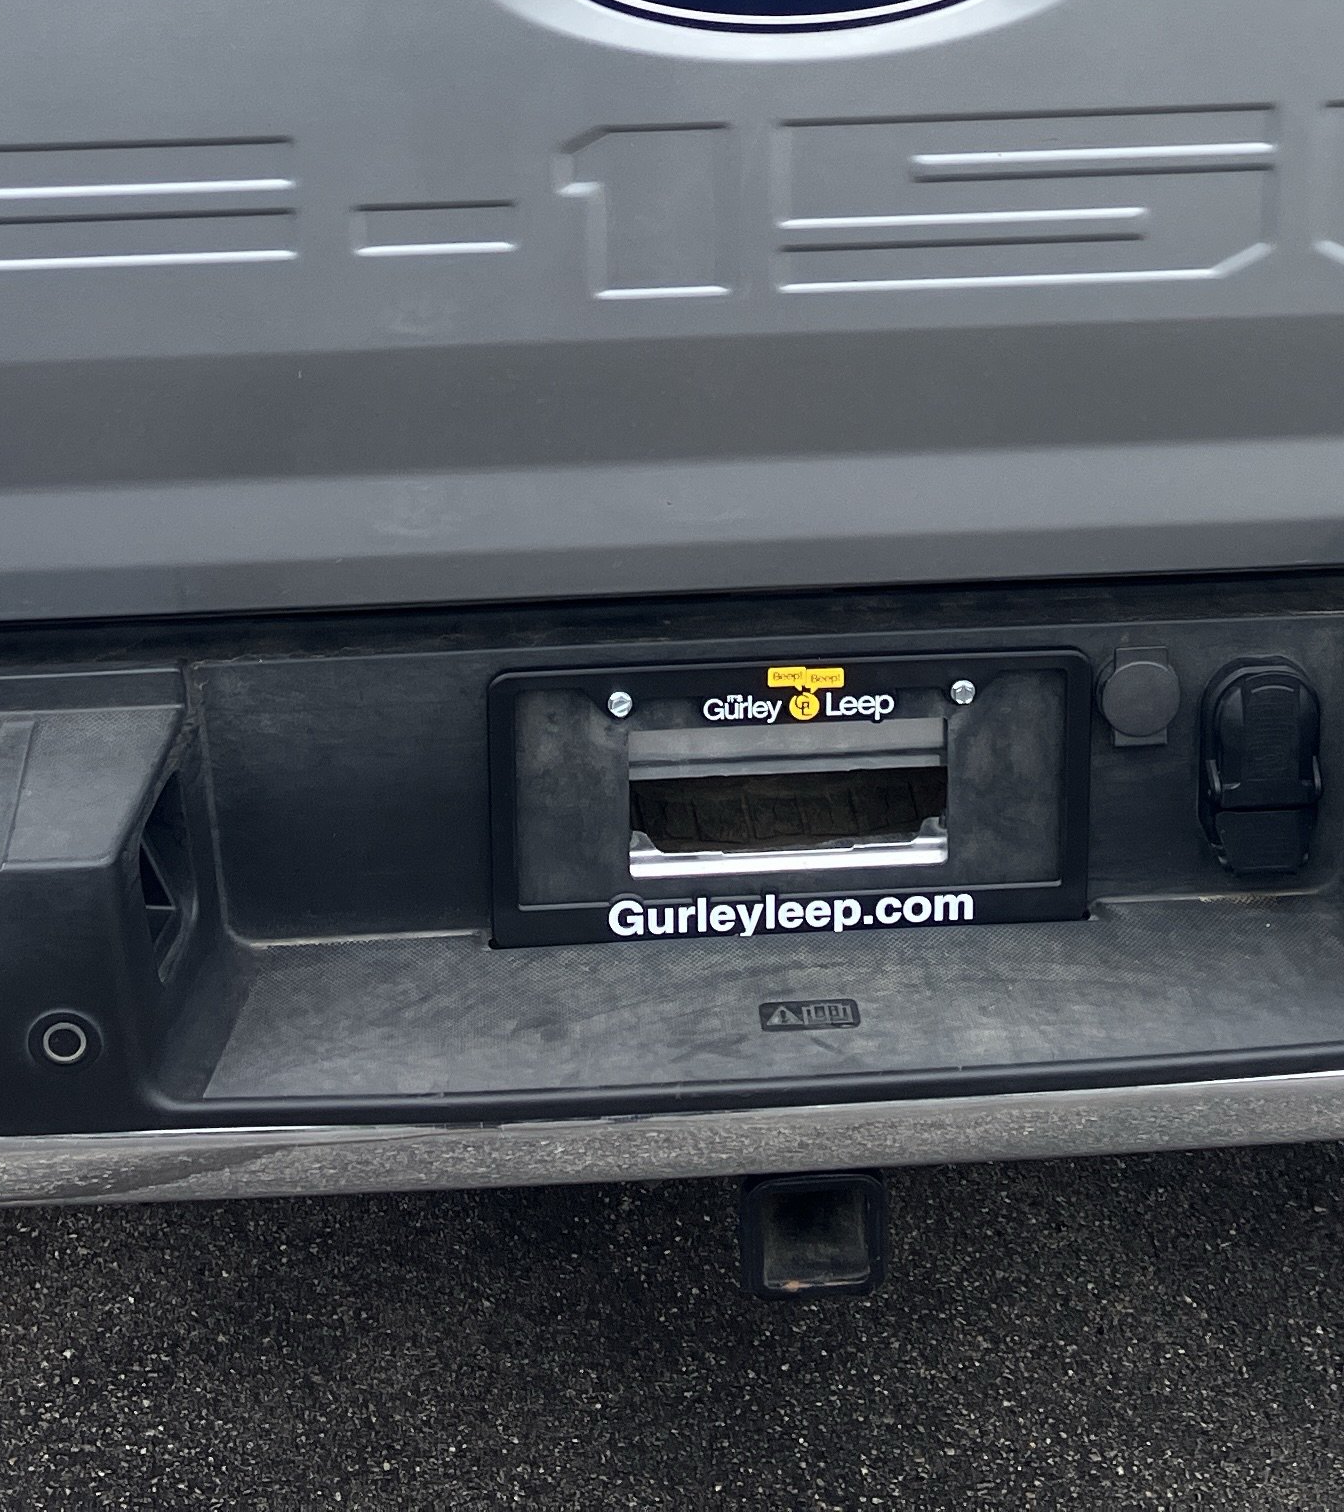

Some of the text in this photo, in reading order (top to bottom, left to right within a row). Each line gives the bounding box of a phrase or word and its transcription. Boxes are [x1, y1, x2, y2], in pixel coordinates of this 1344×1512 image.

[773, 672, 840, 683] Beep! Beep!
[703, 695, 782, 723] Gurley
[825, 692, 895, 720] Leep
[608, 892, 975, 937] Gurleyleep.com
